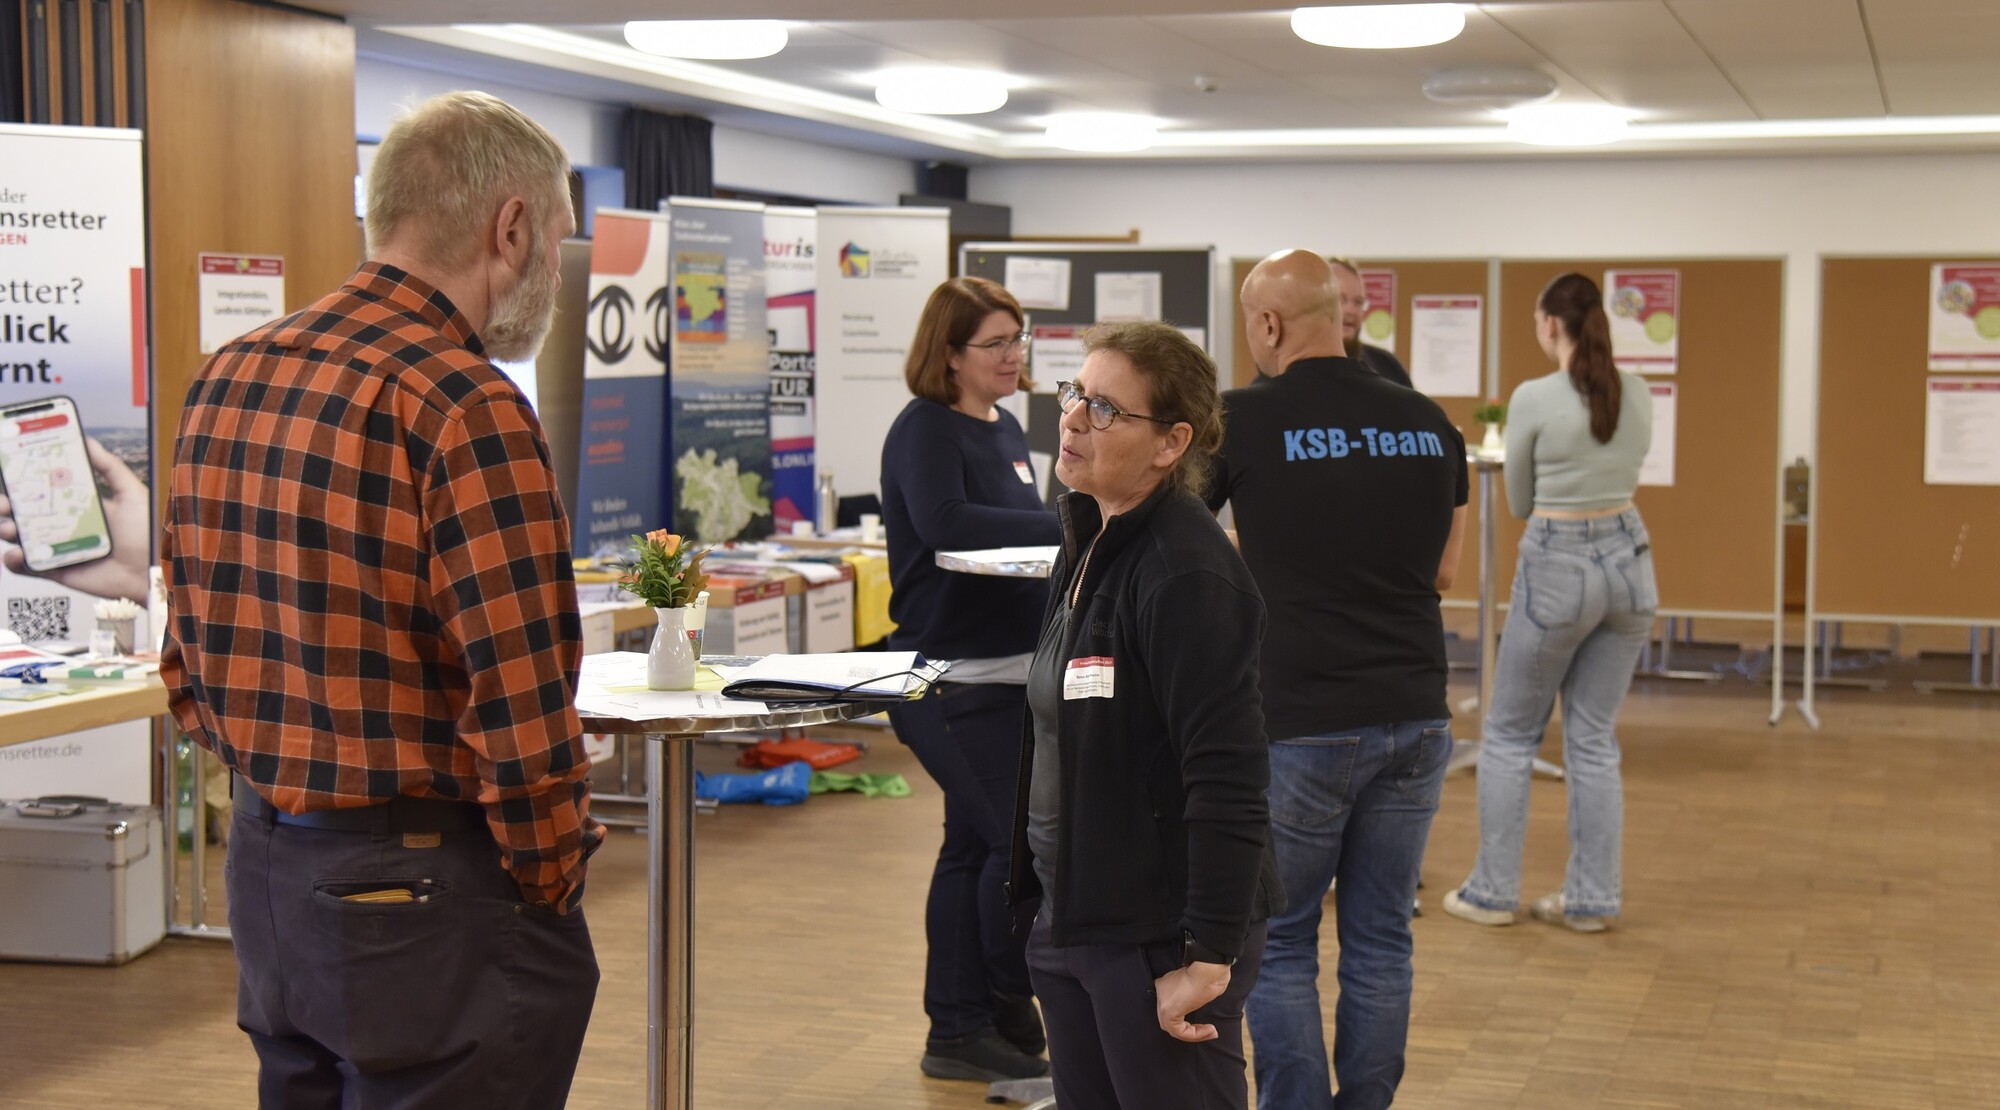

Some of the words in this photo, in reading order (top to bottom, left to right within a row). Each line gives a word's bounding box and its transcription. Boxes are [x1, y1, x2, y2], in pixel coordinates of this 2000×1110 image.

[0, 211, 107, 230] nsretter
[0, 314, 70, 344] lick
[1284, 427, 1444, 461] KSB-Team
